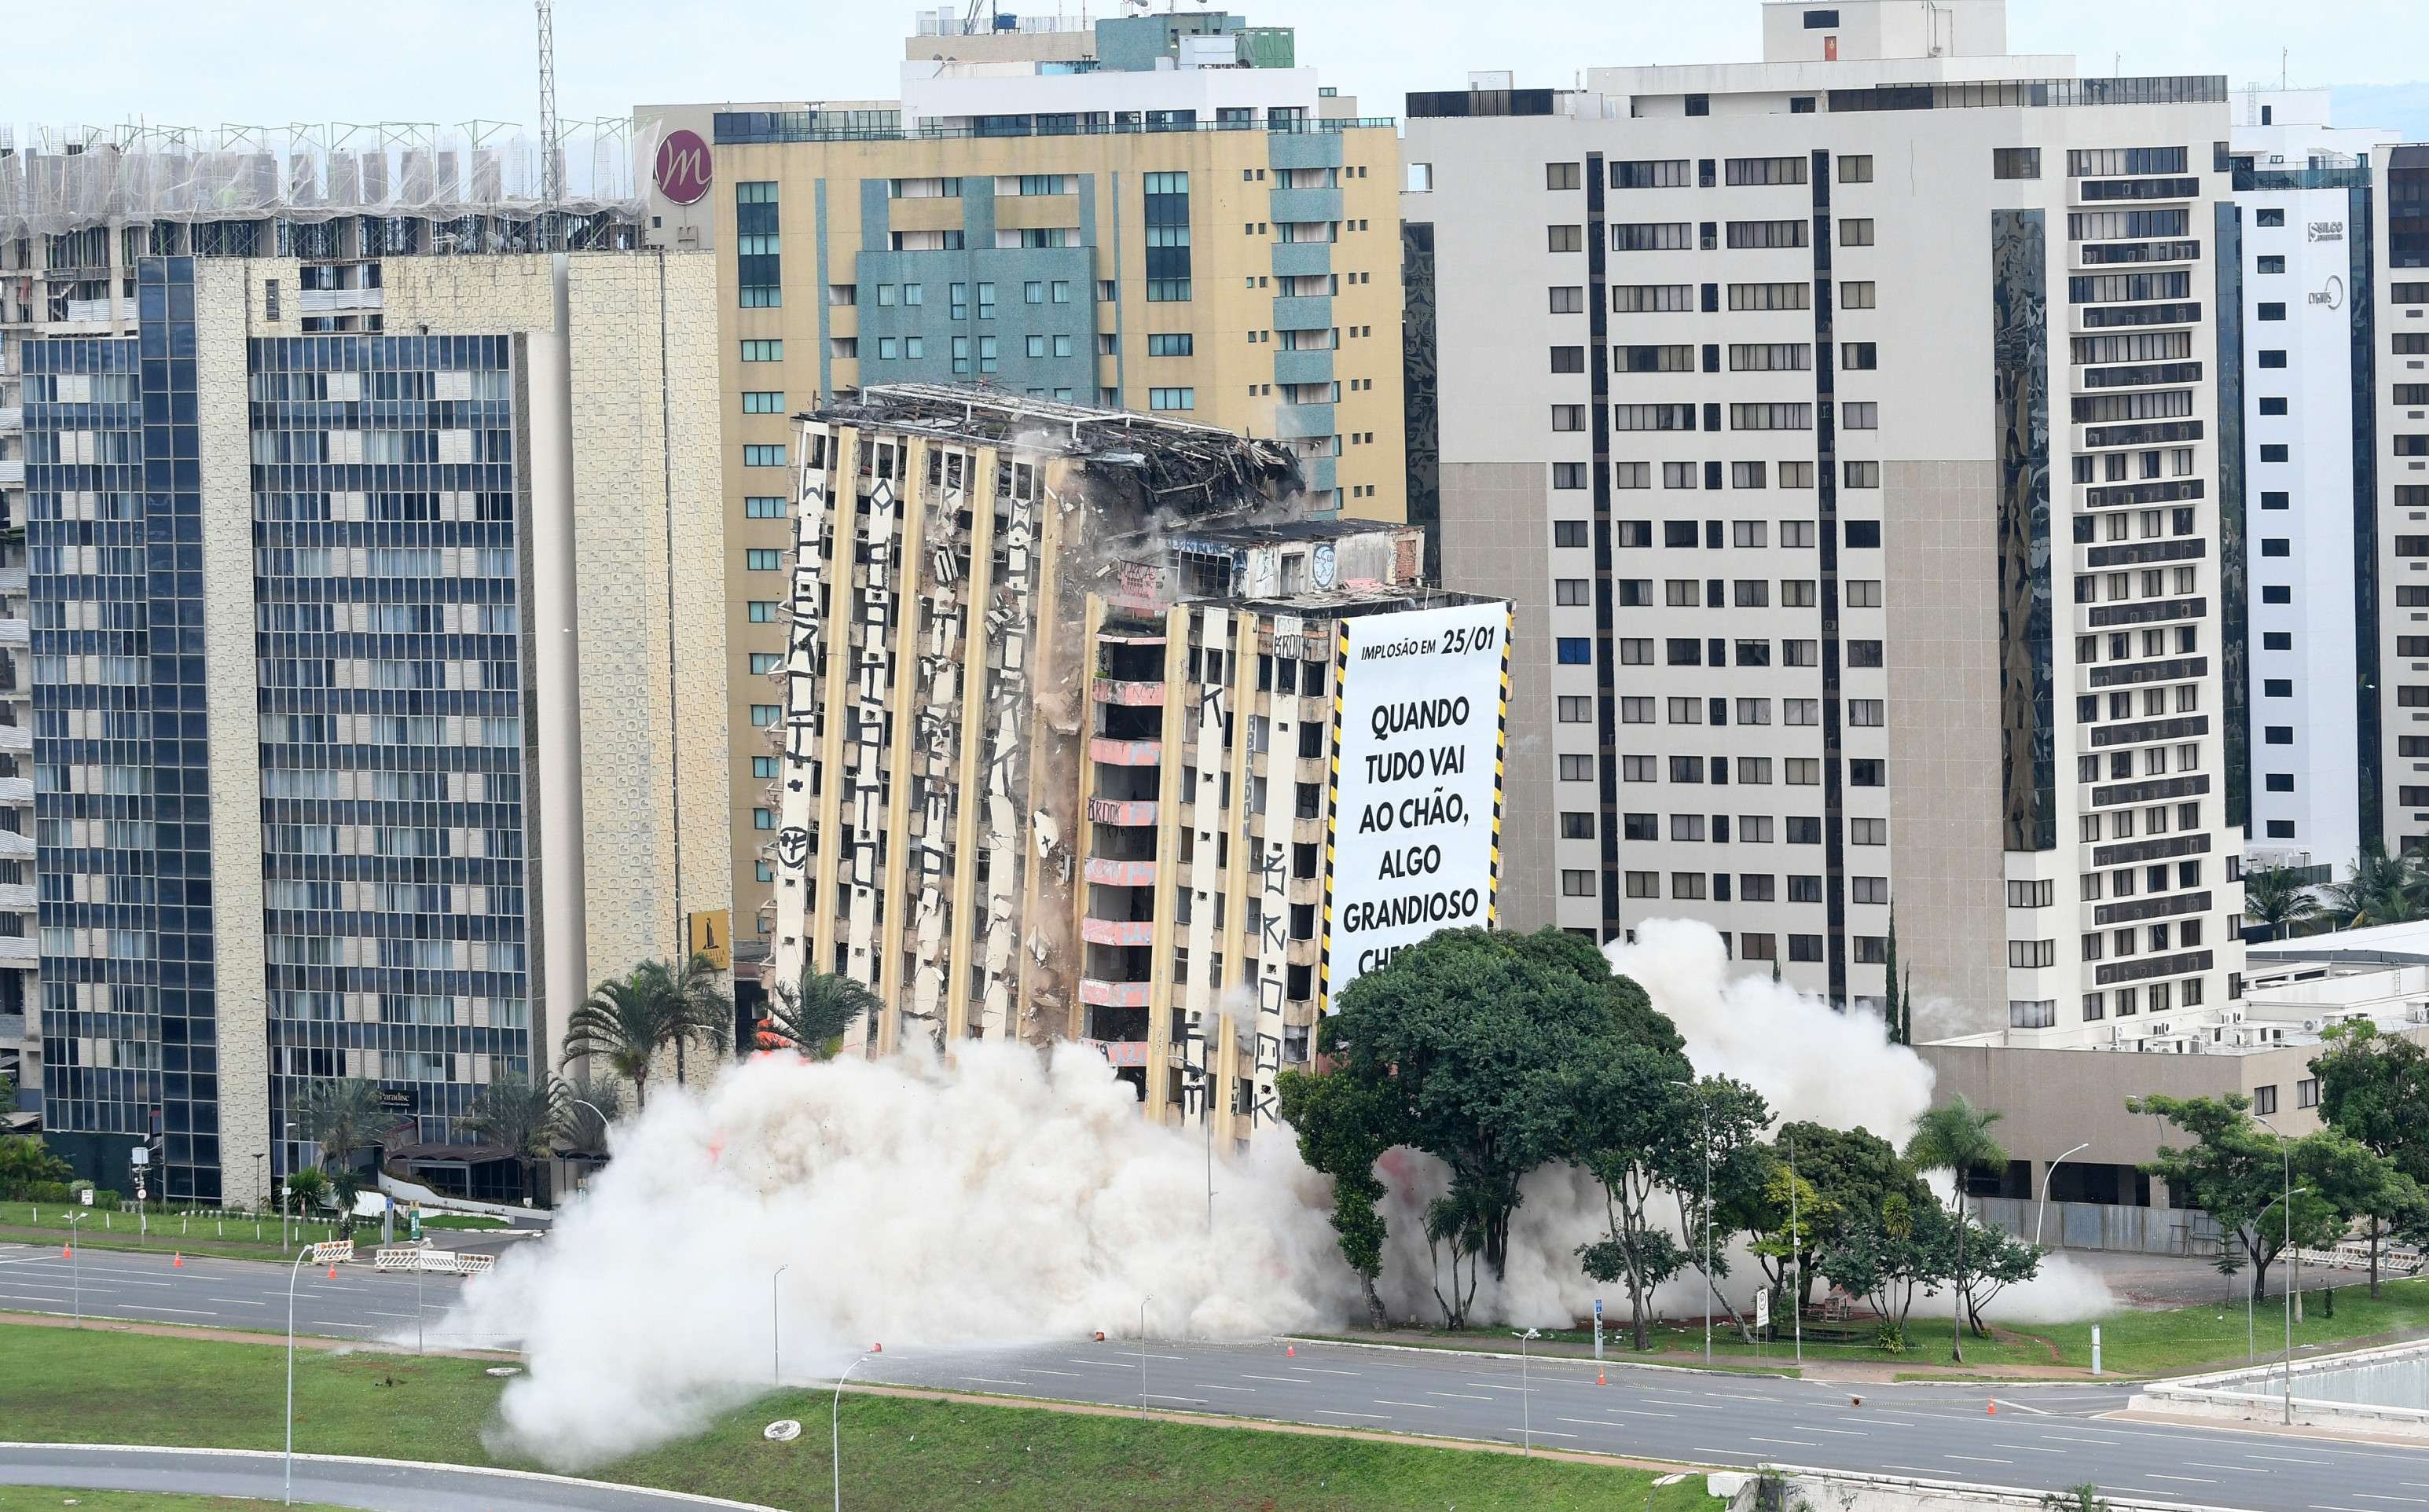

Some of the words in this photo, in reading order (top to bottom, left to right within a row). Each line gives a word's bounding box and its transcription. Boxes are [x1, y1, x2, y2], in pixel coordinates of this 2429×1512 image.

[1361, 638, 1418, 661] IMPLOSÃO
[1421, 639, 1436, 655] EM
[1440, 626, 1495, 655] 25/01
[1371, 695, 1470, 741] QUANDO
[1365, 749, 1425, 784] TUDO
[1429, 744, 1465, 776] VAI
[1359, 802, 1394, 834] AO
[1399, 786, 1469, 829] CHÃO,
[1378, 844, 1441, 880] ALGO
[1343, 888, 1479, 933] GRANDIOSO
[1358, 943, 1415, 976] CH
